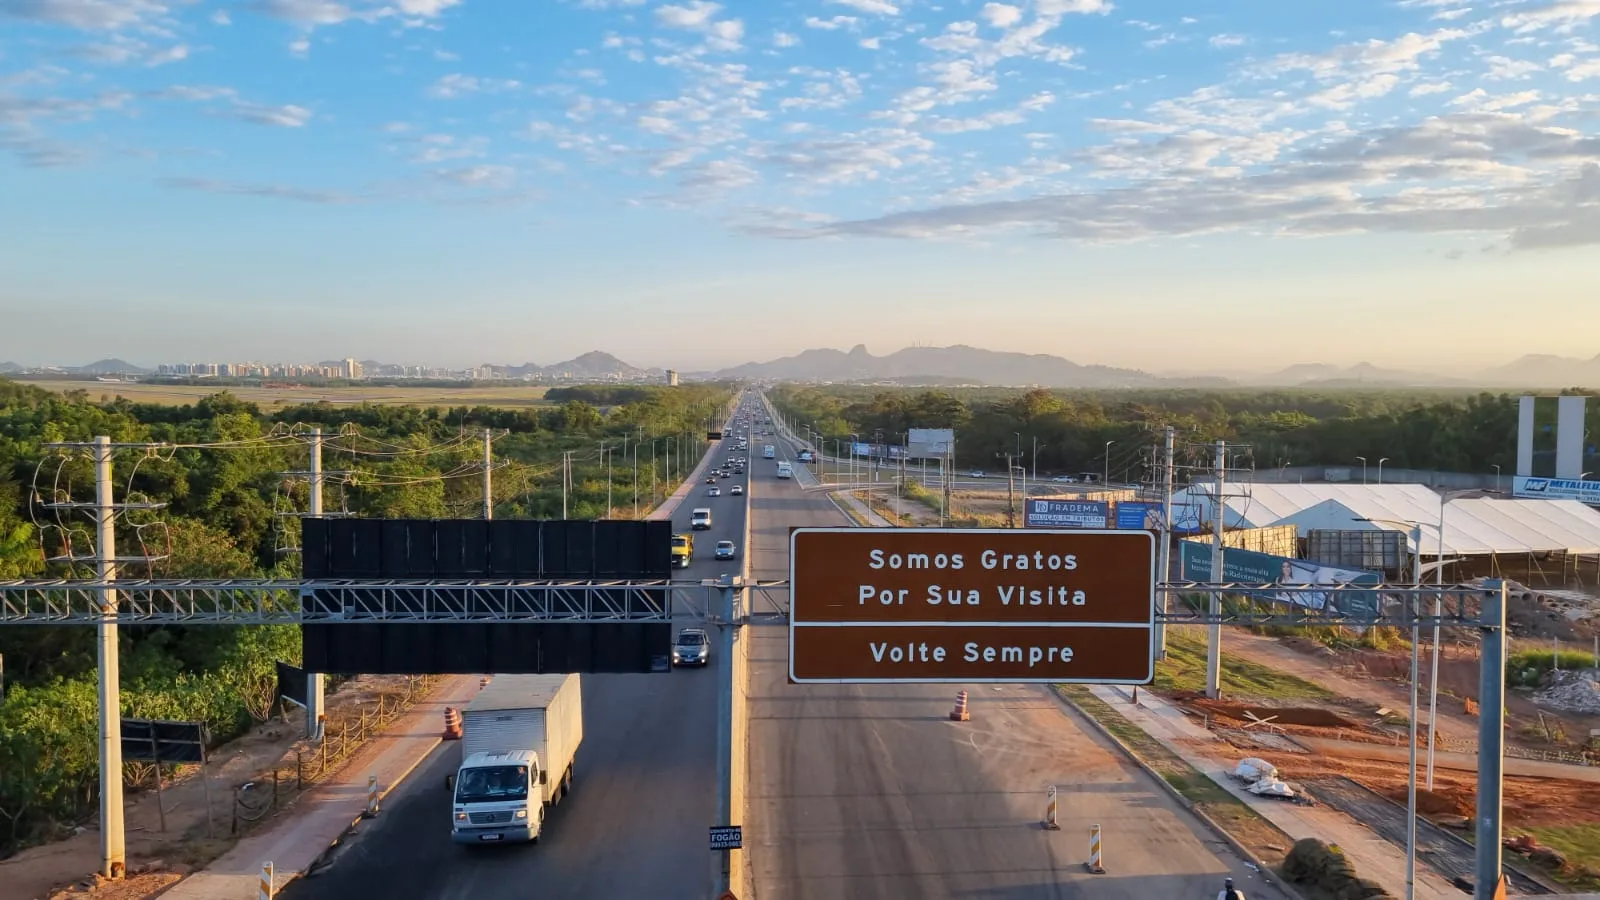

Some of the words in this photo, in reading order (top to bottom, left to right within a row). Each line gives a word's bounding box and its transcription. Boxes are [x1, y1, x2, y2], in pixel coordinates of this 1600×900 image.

[1049, 503, 1099, 512] FRADEMA
[869, 549, 964, 570] Somos
[981, 549, 1078, 570] Gratos
[859, 584, 909, 605] Por
[926, 584, 980, 605] Sua
[997, 585, 1086, 606] Visita
[869, 642, 946, 663] Volte
[963, 642, 1074, 667] Sempre
[711, 832, 741, 842] FOGÃO
